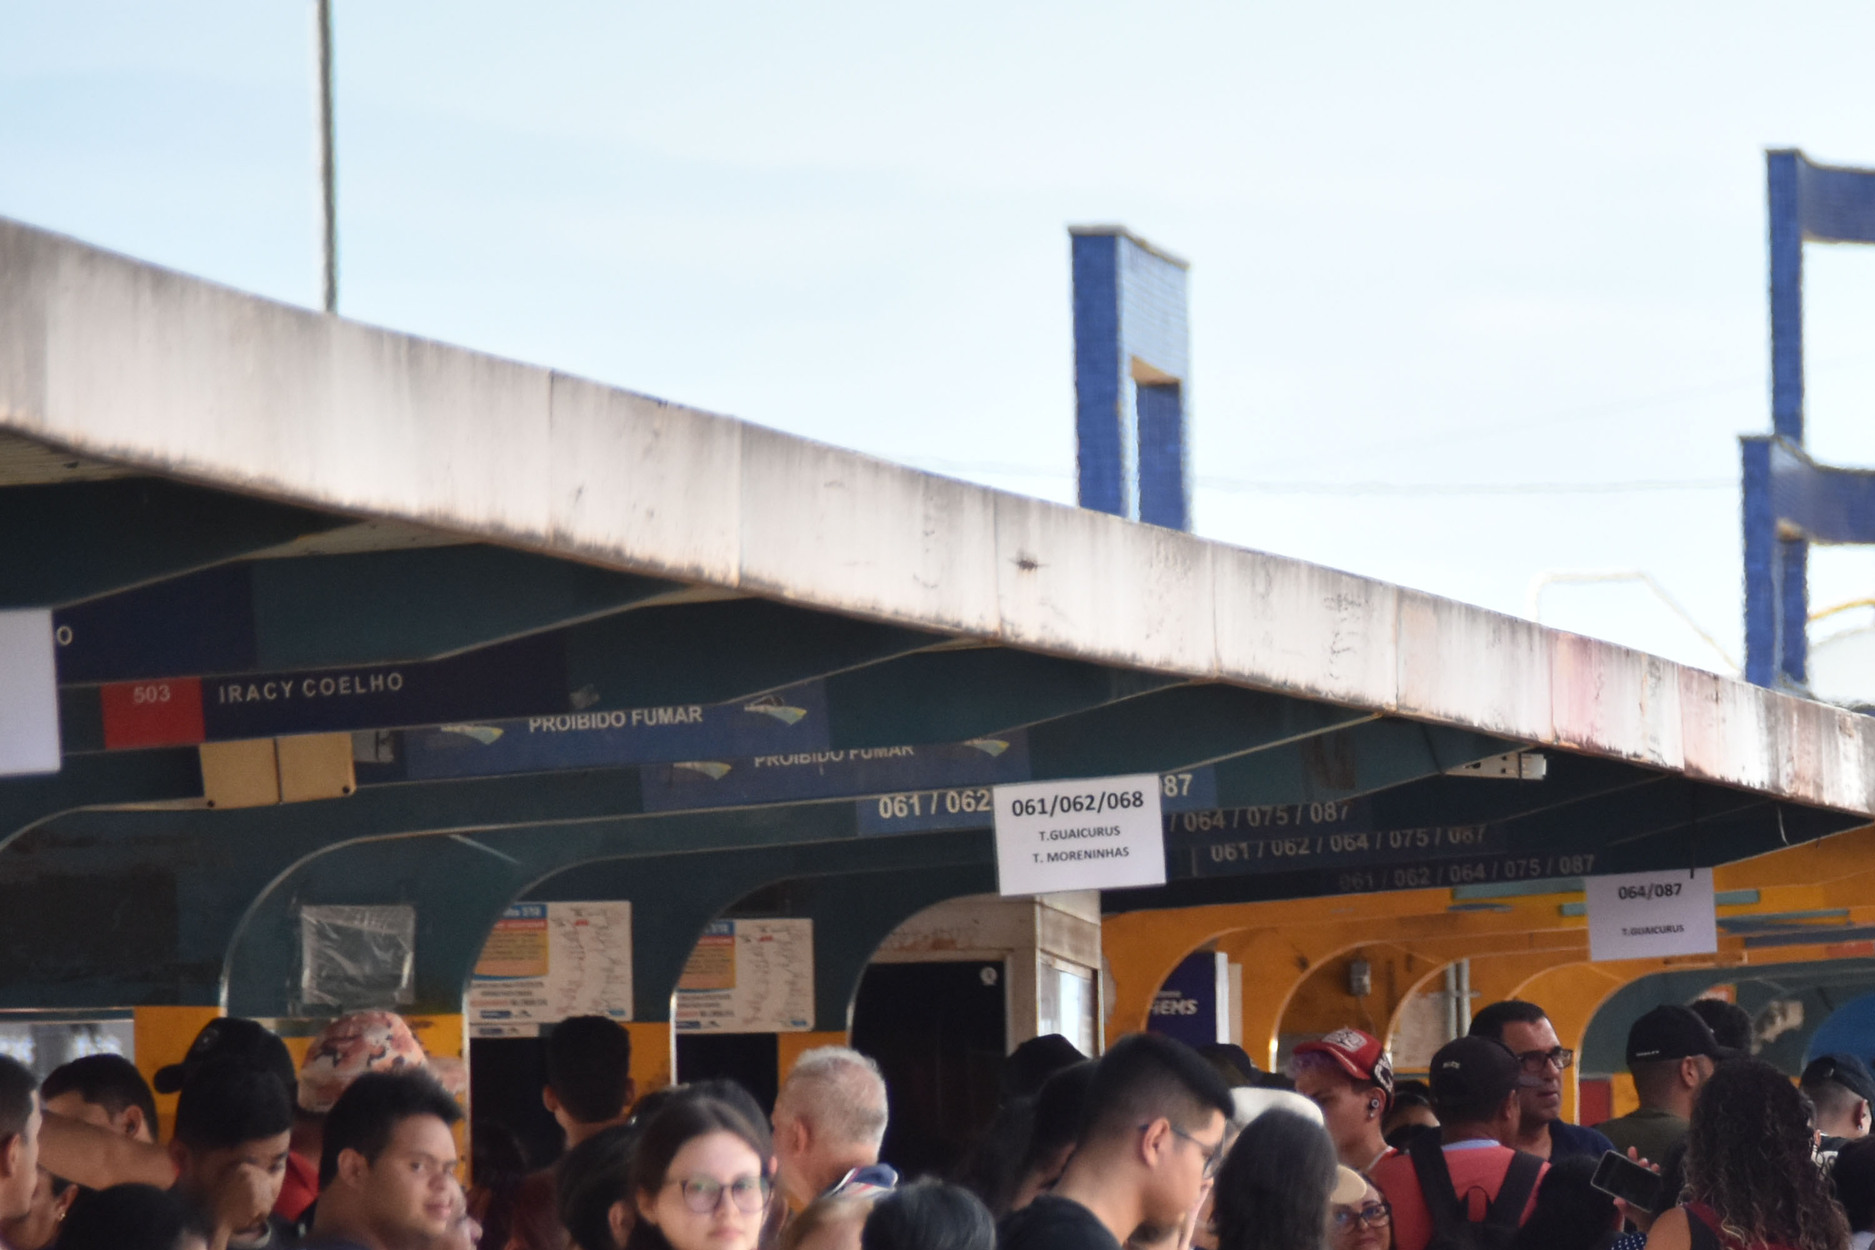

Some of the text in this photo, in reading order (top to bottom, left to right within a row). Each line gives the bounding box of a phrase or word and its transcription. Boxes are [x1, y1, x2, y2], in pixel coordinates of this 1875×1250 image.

[133, 685, 171, 704] 503
[218, 672, 404, 704] IRACY COELHO
[528, 705, 703, 733] PROIBIDO FUMAR
[878, 791, 922, 819] 061
[945, 789, 992, 815] 062
[1161, 773, 1193, 798] 87
[1011, 790, 1145, 819] 061/062/068
[1183, 809, 1226, 832] 064
[1247, 805, 1290, 827] 075
[1039, 825, 1121, 842] T.GUAICURUS
[1211, 842, 1250, 862] 061
[1271, 837, 1311, 856] 062
[1330, 833, 1369, 852] 064
[1389, 828, 1430, 848] 075
[1033, 846, 1130, 865] T. MORENINHAS
[1618, 882, 1683, 901] 064/087
